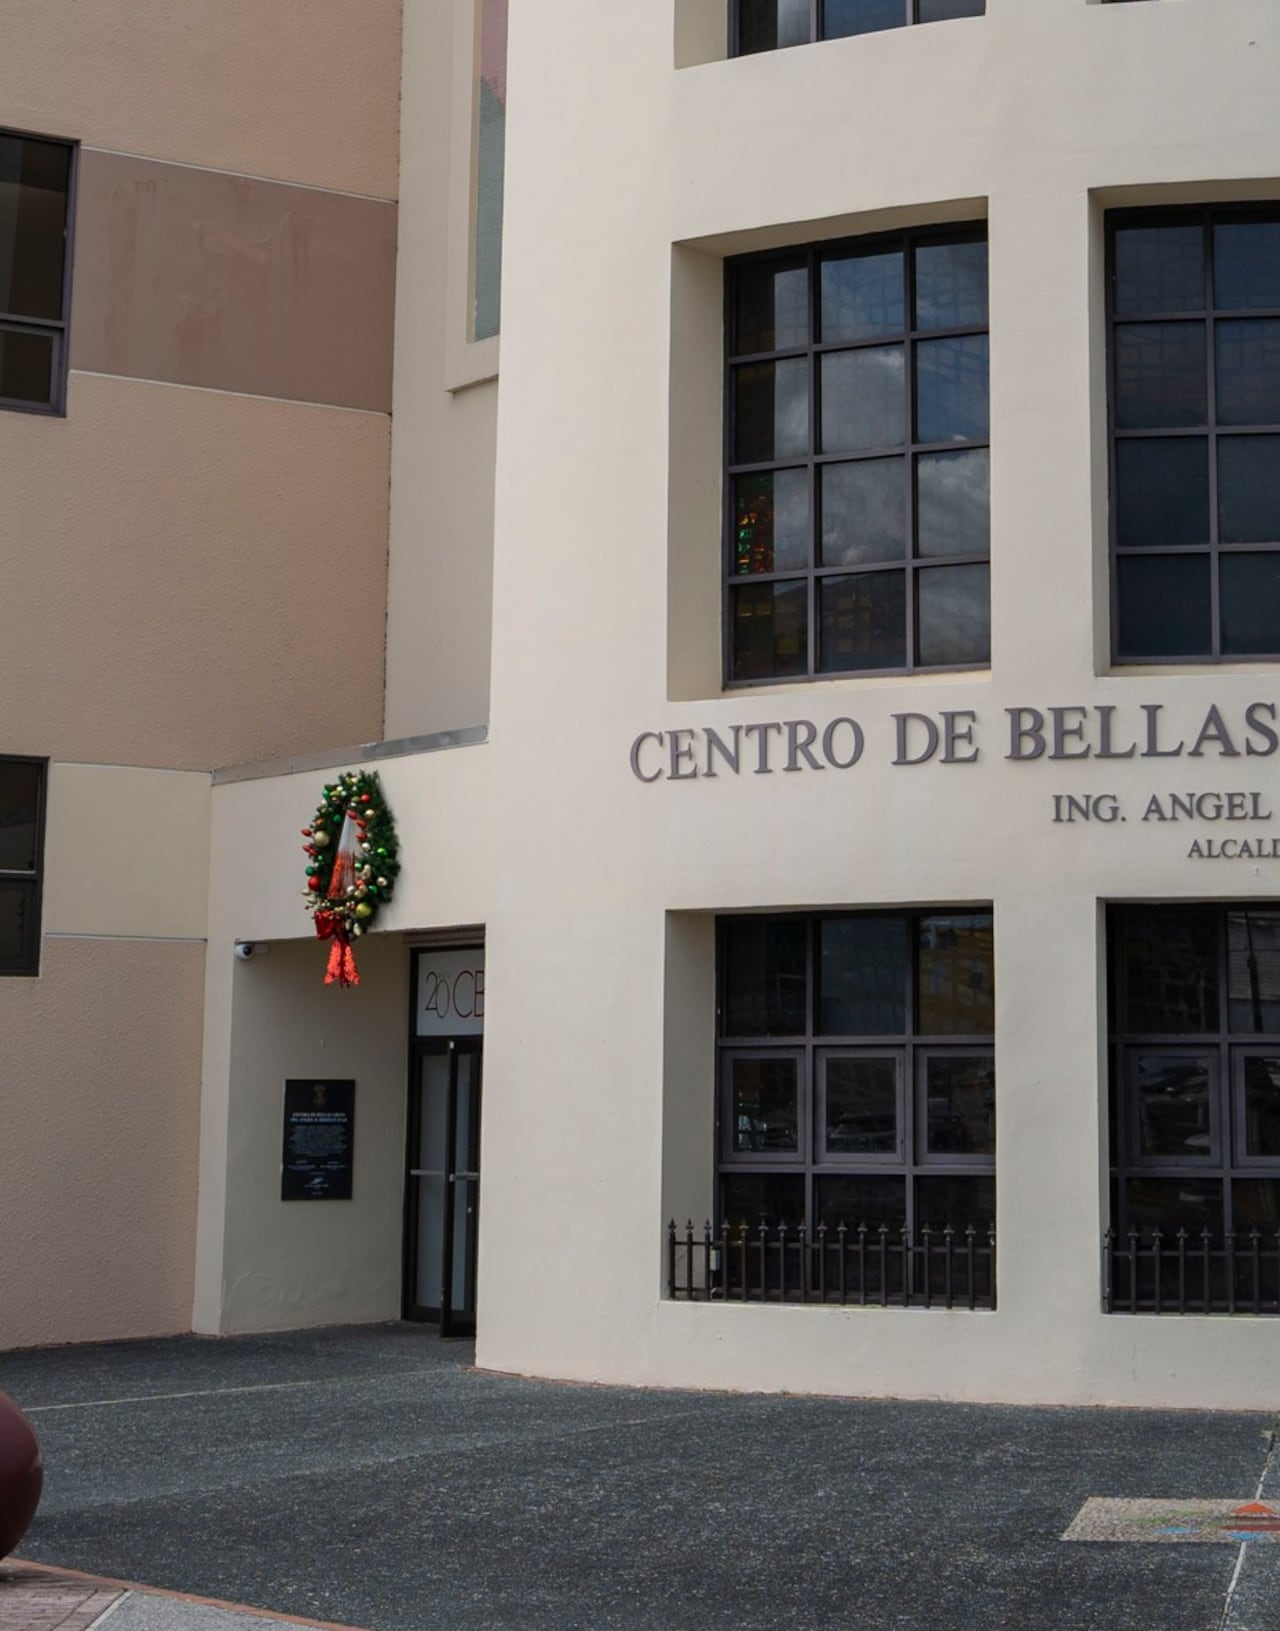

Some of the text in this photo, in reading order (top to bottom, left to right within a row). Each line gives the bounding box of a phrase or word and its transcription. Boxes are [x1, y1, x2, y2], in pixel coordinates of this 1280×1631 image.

[630, 716, 864, 783] CENTRO
[890, 709, 980, 766] DE
[1003, 702, 1279, 763] BELLAS
[1052, 794, 1127, 823] ING.
[1141, 792, 1272, 822] ANGEL
